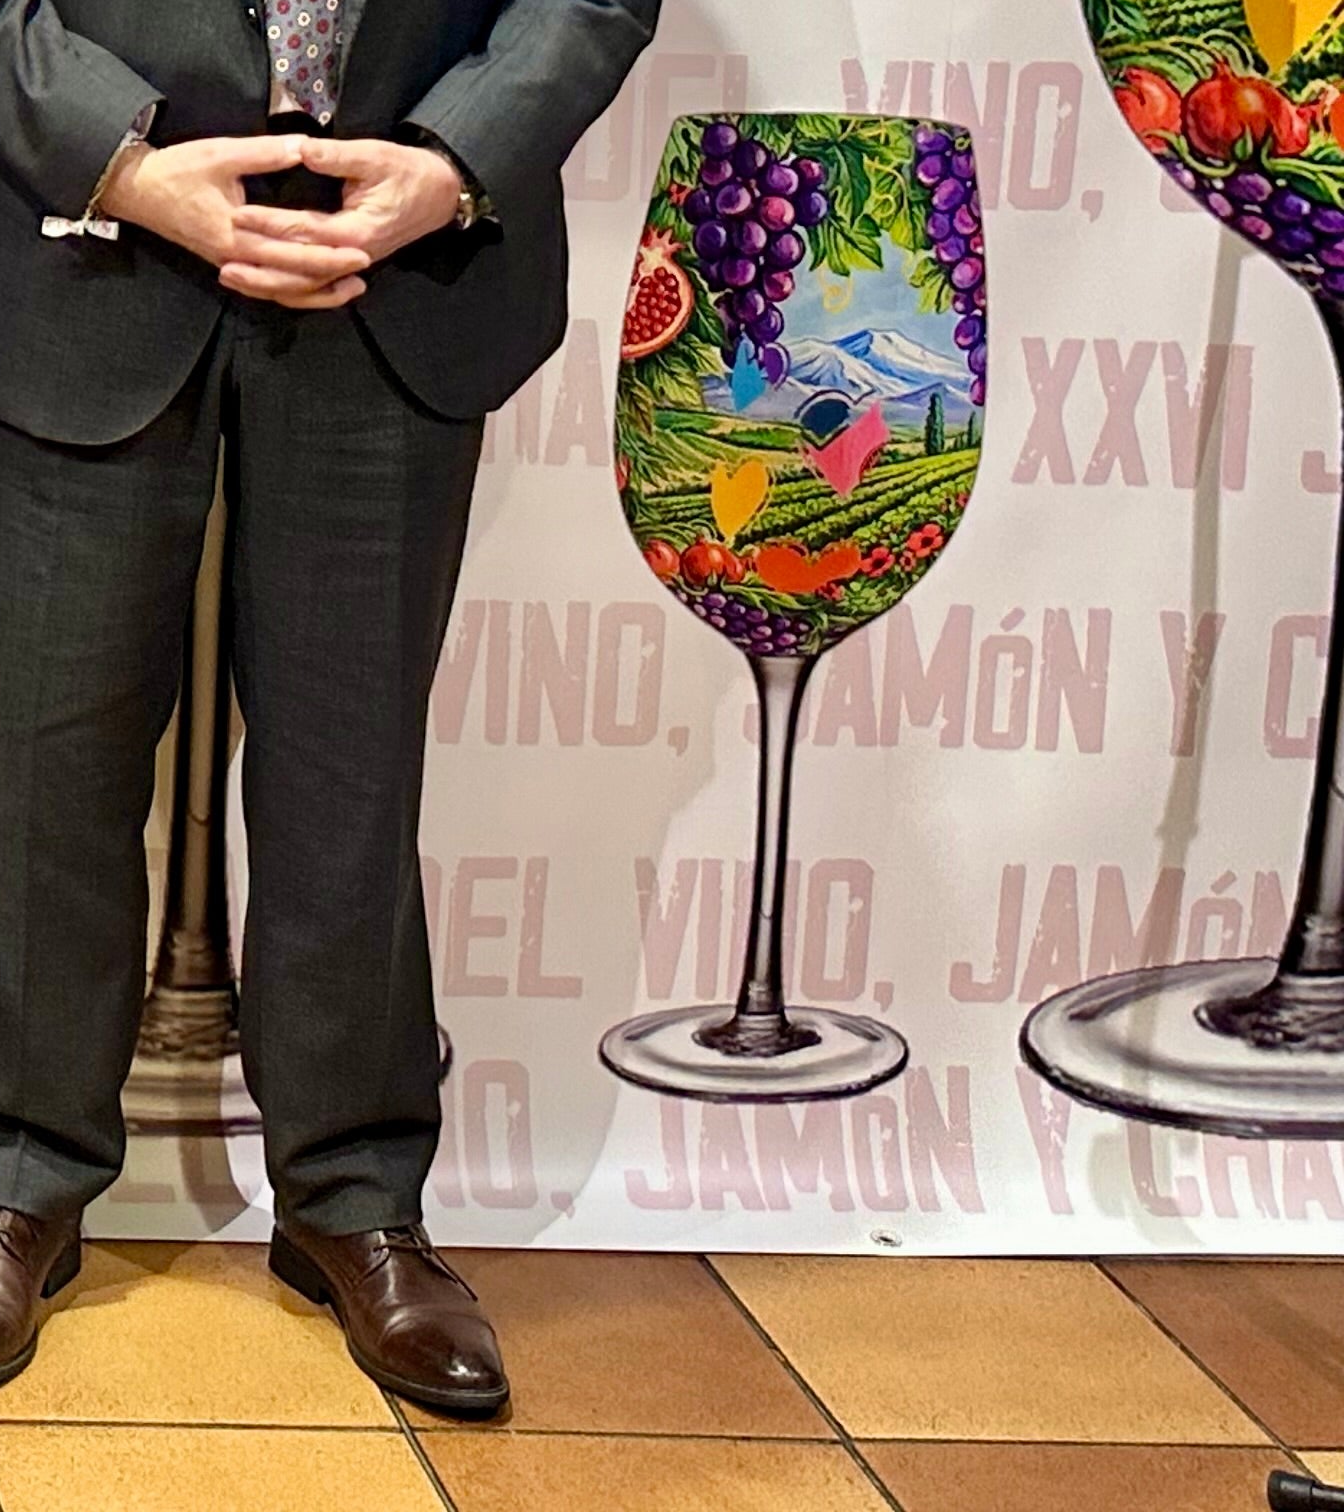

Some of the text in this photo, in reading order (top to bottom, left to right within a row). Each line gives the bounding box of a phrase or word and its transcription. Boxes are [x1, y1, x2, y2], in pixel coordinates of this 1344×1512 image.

[1012, 336, 1255, 491] XXVI
[431, 599, 690, 757] VINO,
[1160, 609, 1227, 757] Y
[1015, 1064, 1075, 1215] Y
